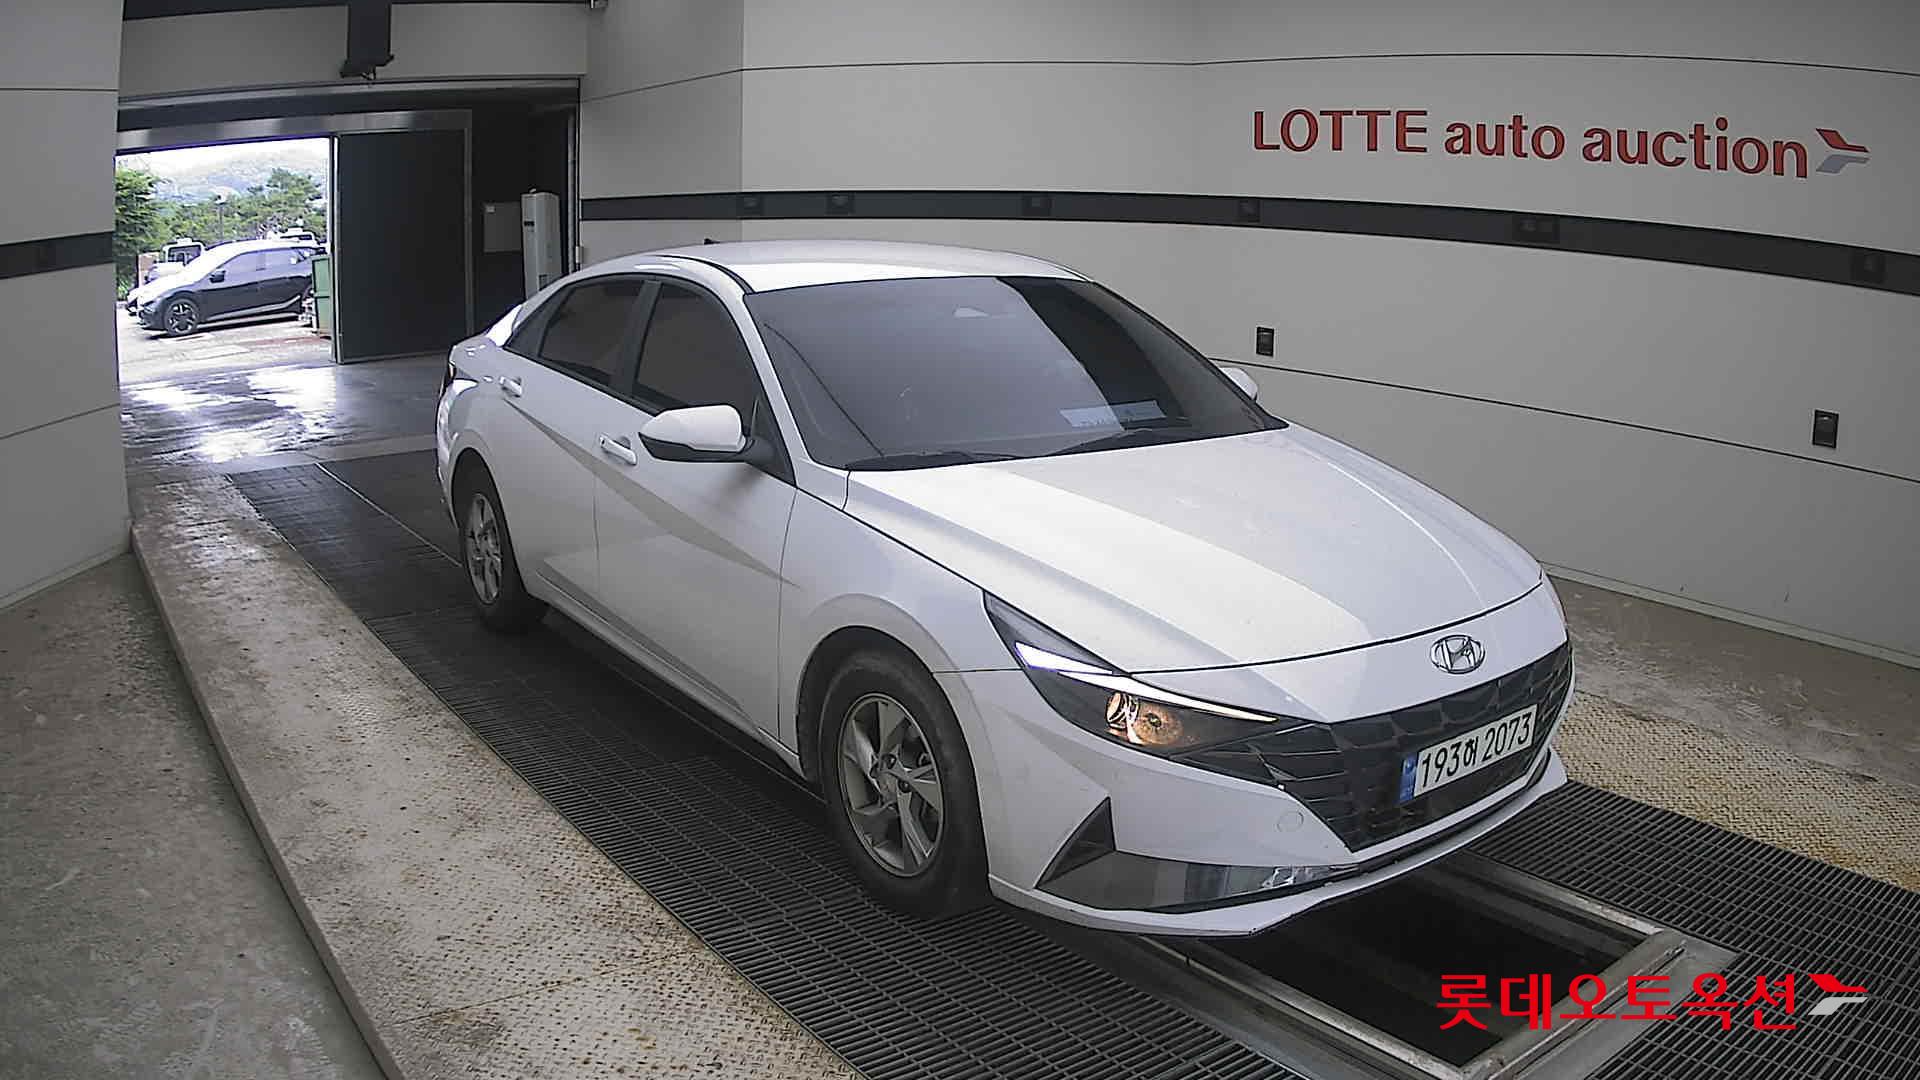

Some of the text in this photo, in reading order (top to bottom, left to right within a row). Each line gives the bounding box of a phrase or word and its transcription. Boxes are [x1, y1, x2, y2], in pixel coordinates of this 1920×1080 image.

[1253, 108, 1809, 178] LOTTE auto auction
[1483, 712, 1532, 762] 2073
